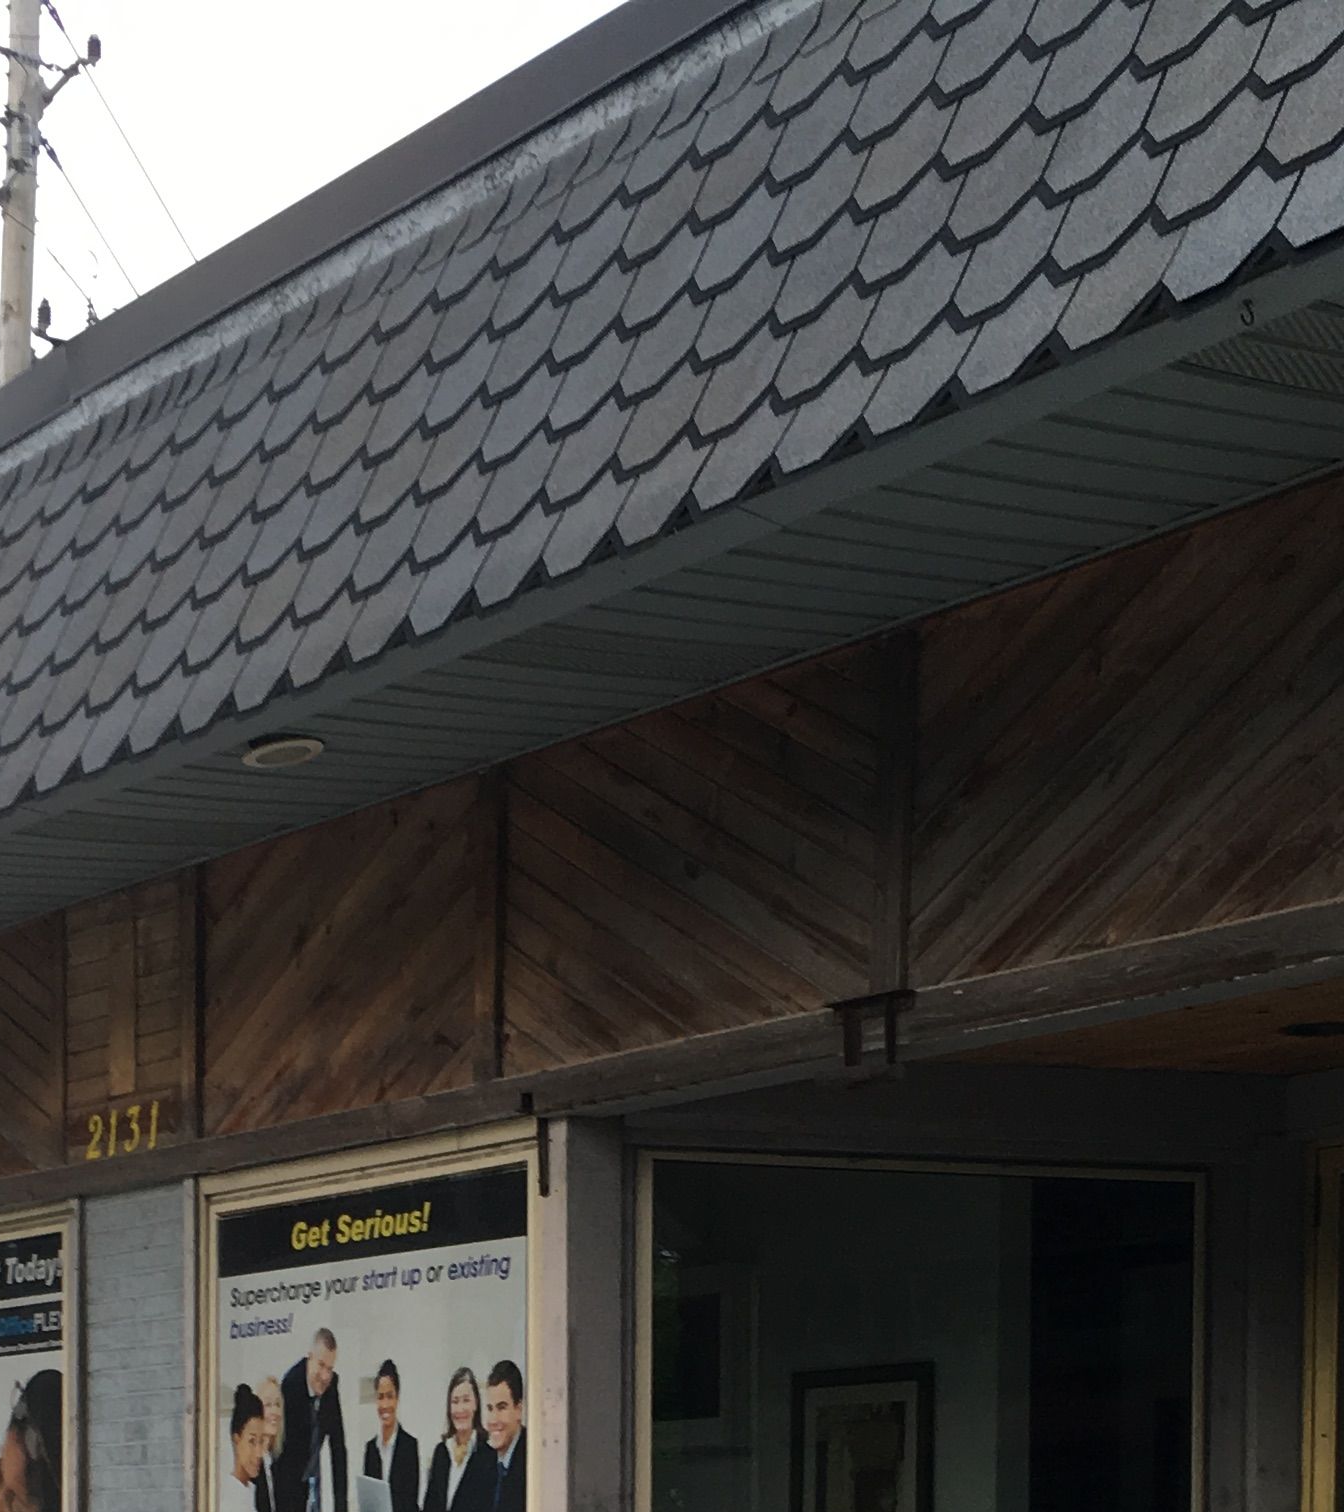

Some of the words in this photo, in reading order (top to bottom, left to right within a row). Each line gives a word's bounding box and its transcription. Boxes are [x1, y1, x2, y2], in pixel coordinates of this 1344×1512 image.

[85, 1100, 159, 1160] 2131
[291, 1220, 330, 1250] Get
[335, 1202, 431, 1244] Serious!
[230, 1278, 321, 1310] Supercharge
[324, 1275, 359, 1300] your
[362, 1267, 398, 1291] start
[401, 1267, 422, 1291] up
[426, 1265, 445, 1282] or
[448, 1254, 512, 1280] existing
[229, 1312, 294, 1340] business!
